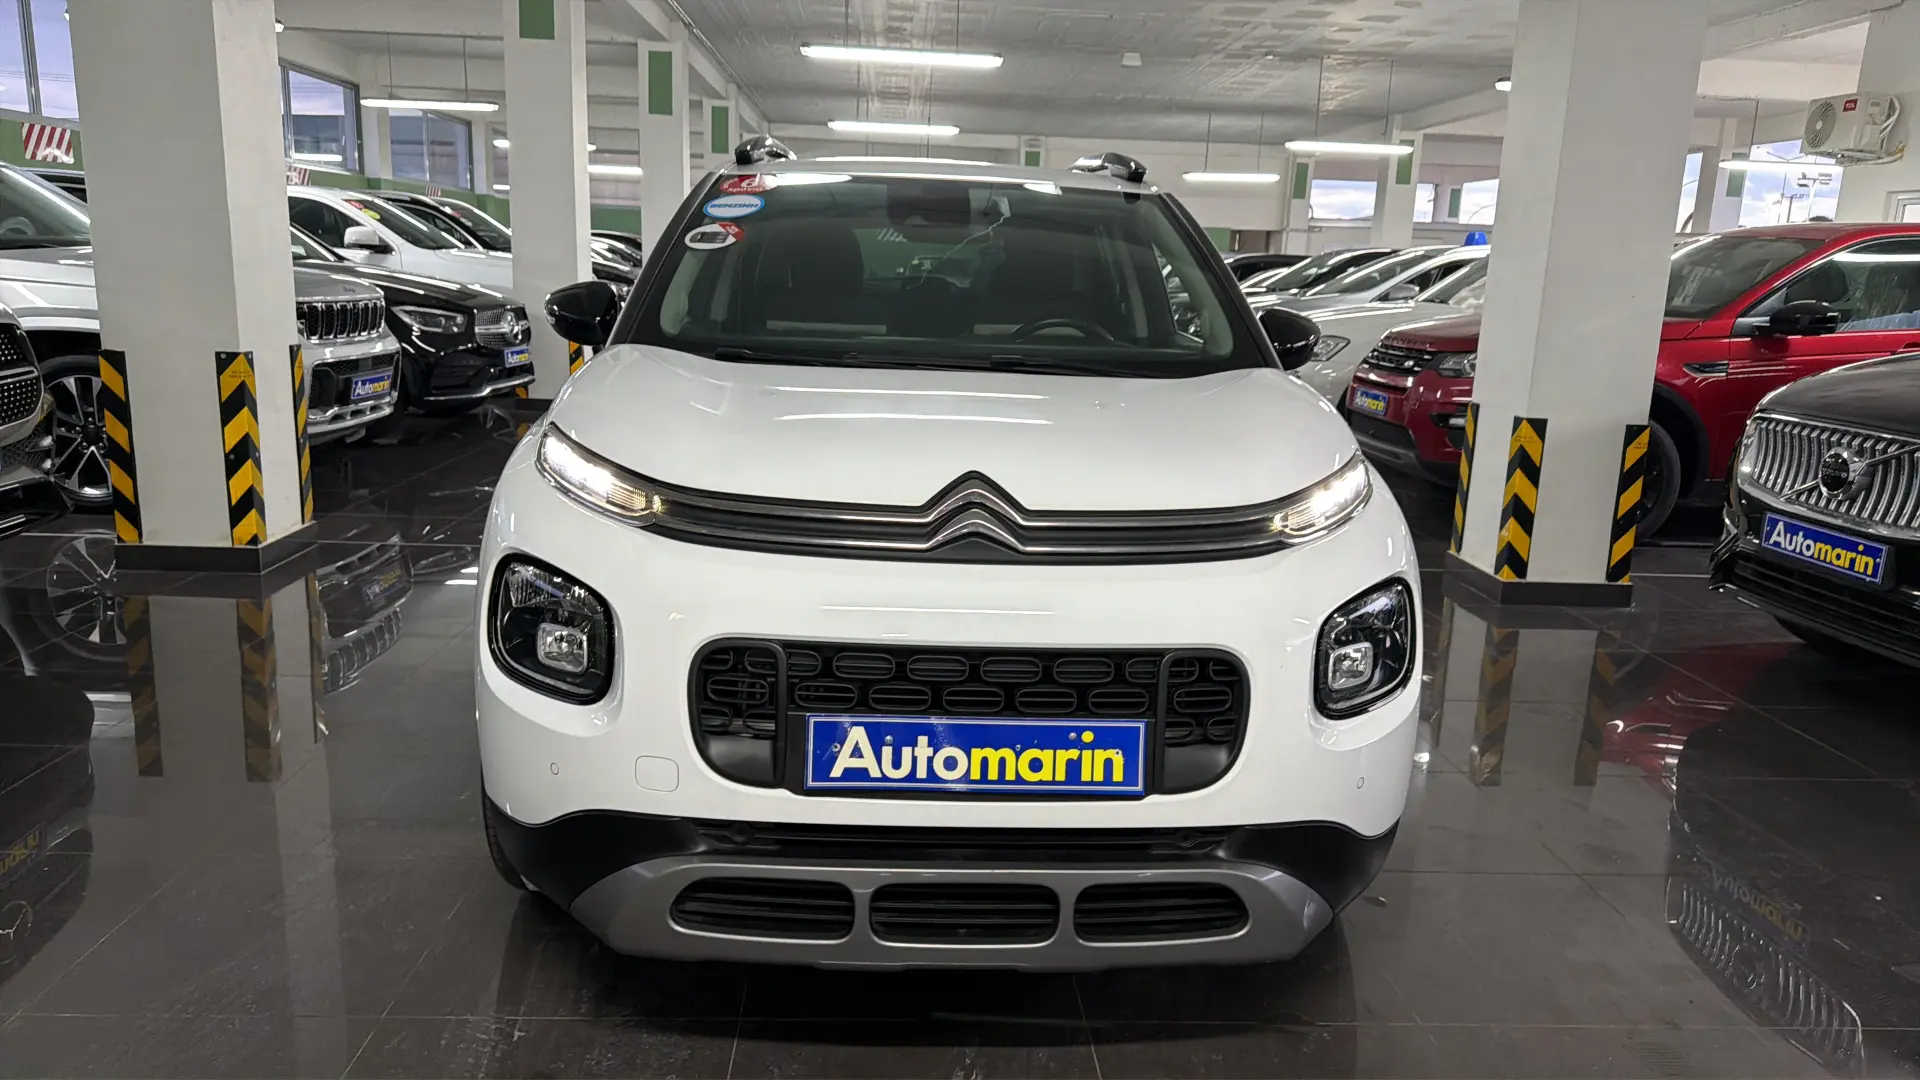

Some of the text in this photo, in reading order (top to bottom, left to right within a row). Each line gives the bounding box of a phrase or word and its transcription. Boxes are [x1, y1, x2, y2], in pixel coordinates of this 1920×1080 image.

[354, 378, 390, 397] Automarin
[1769, 521, 1875, 576] Automarin
[829, 725, 1124, 782] Automarin
